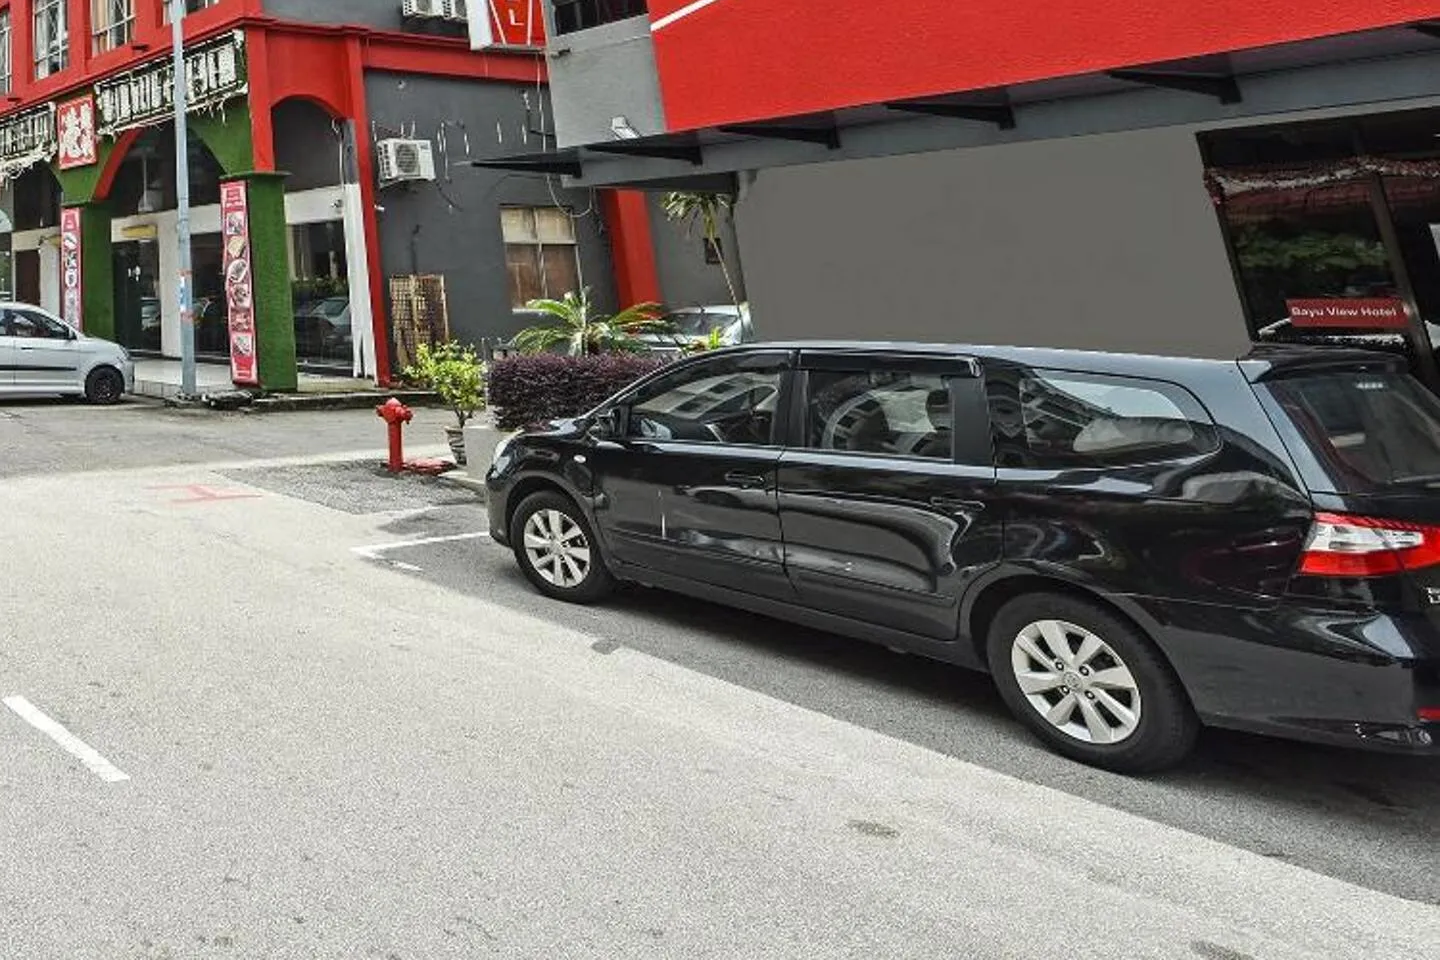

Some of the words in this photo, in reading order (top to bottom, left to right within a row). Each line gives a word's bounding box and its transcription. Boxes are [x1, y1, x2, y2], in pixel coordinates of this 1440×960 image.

[1291, 306, 1324, 318] Bayu
[1326, 306, 1358, 316] View
[1360, 306, 1397, 317] Hotel
